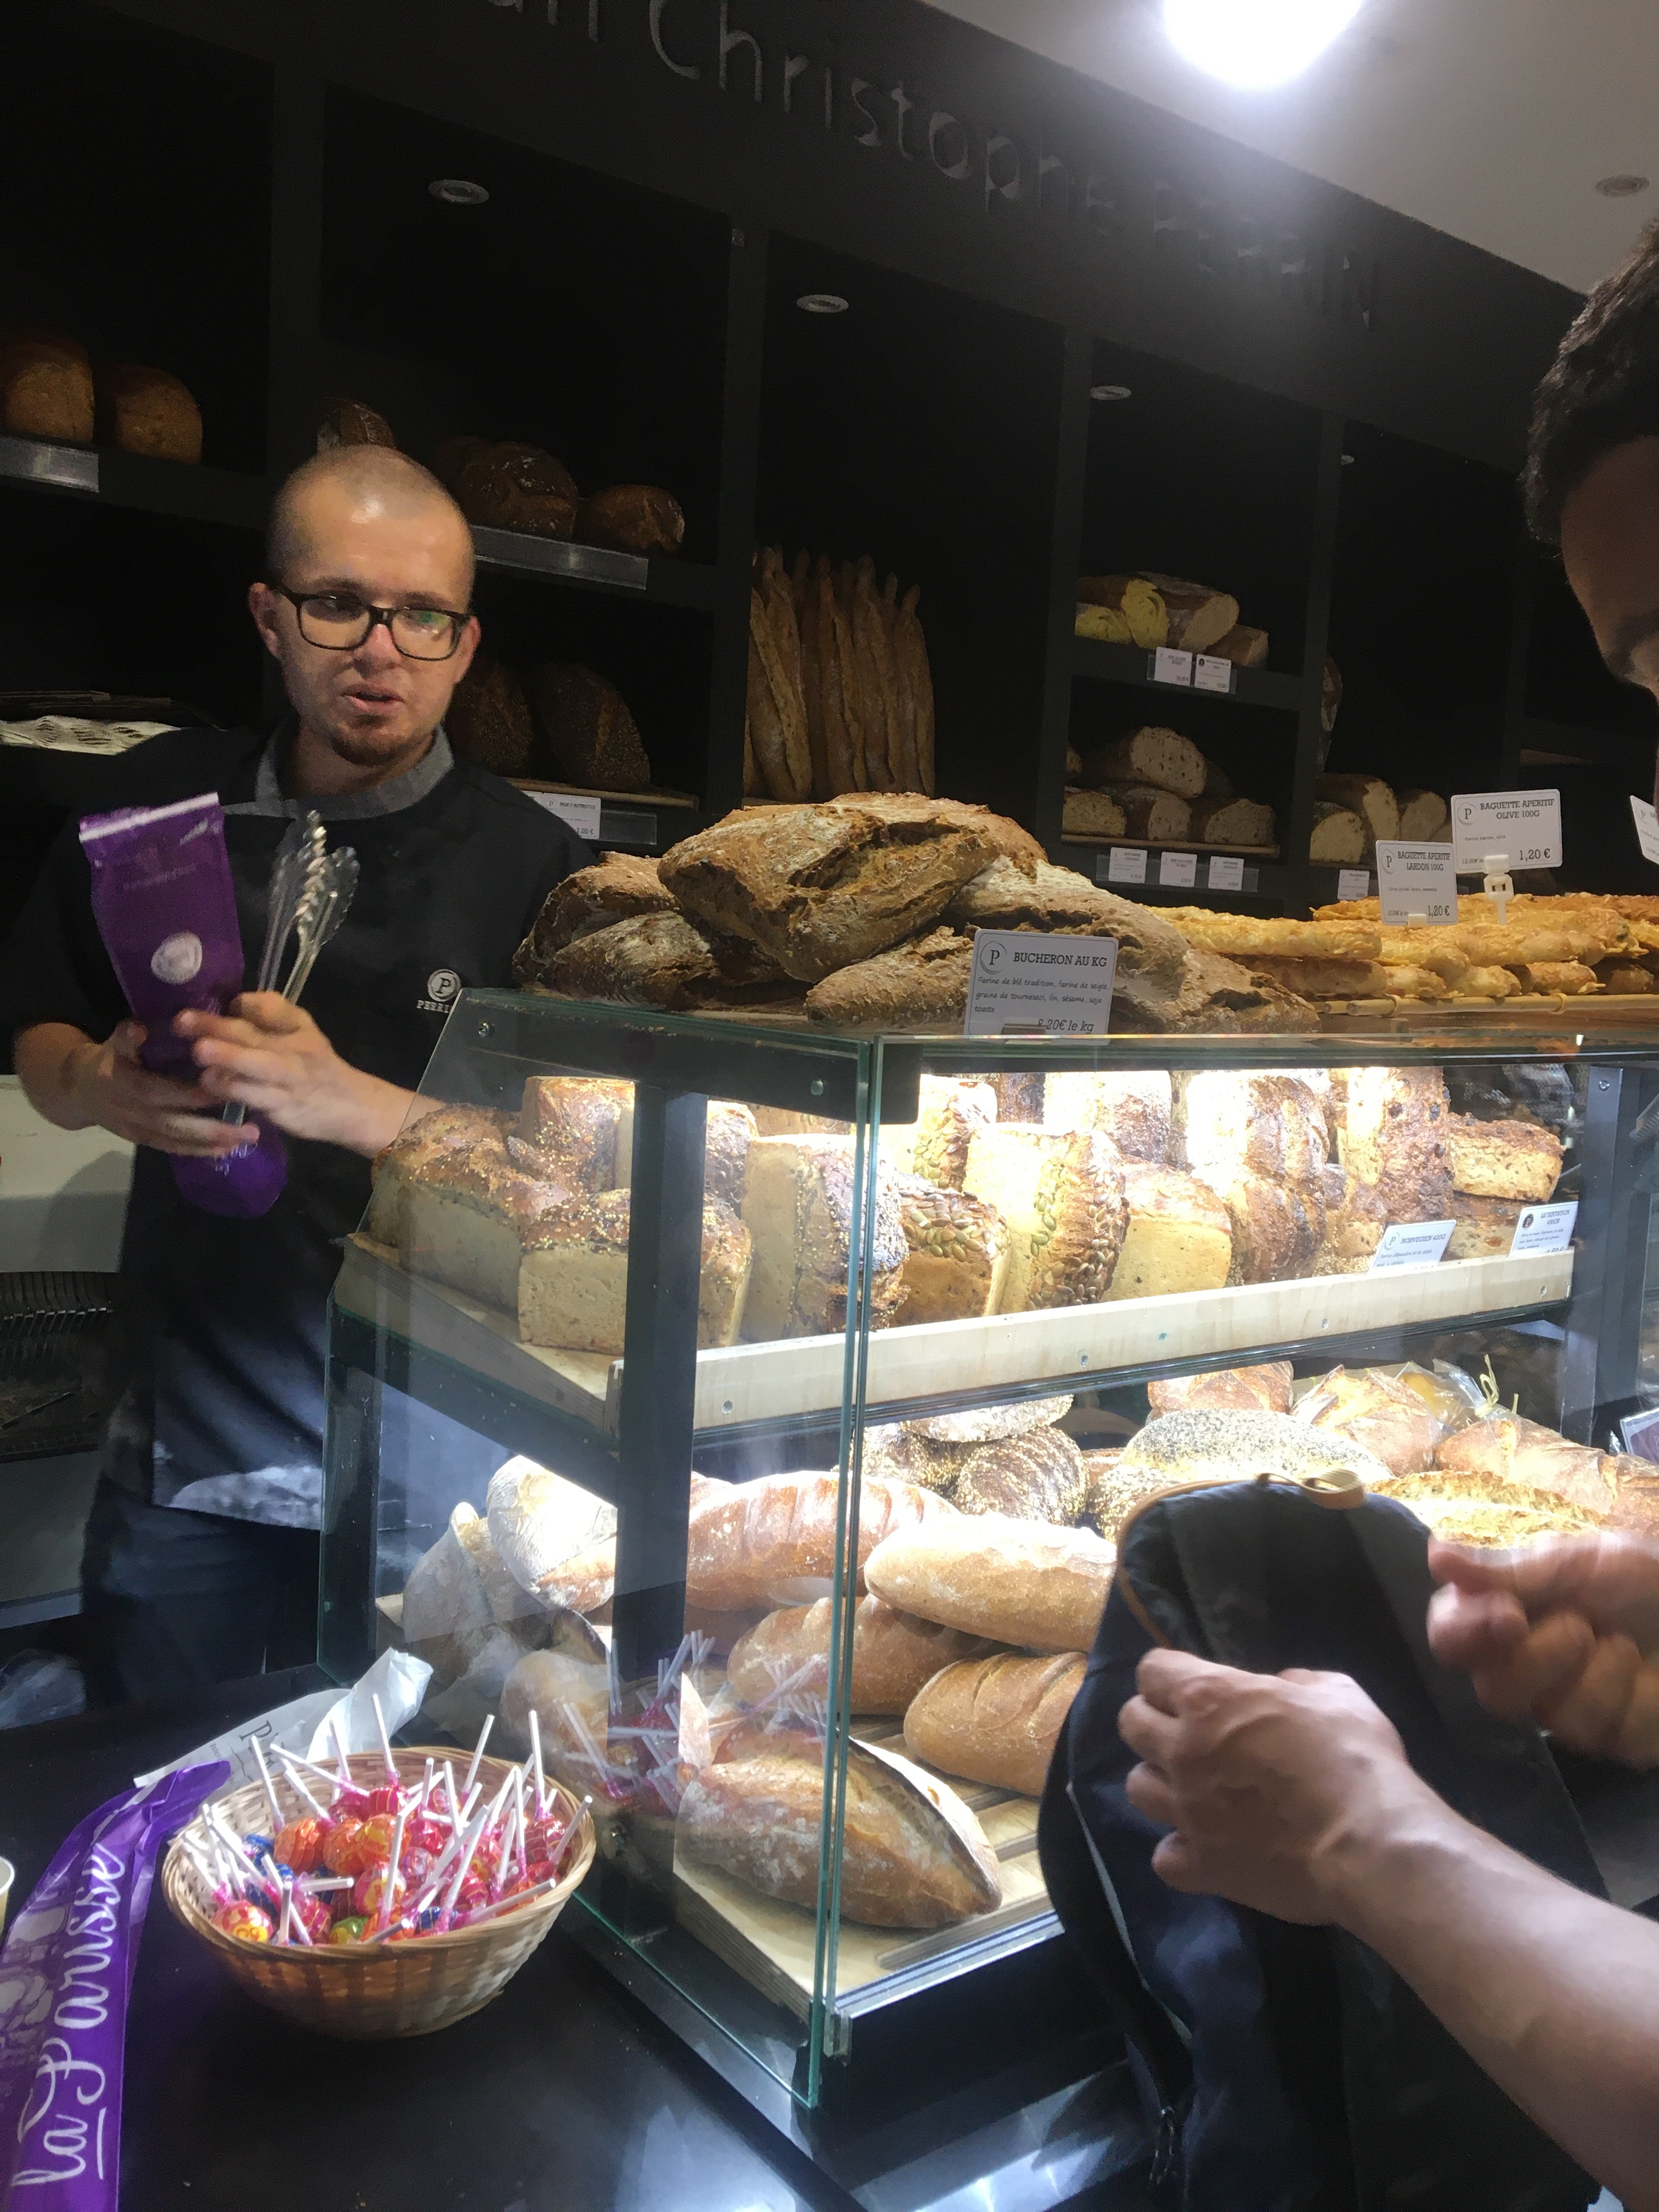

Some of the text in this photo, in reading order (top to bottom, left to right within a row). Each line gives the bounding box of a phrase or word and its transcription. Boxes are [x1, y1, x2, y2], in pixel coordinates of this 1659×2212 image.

[1480, 799, 1555, 810] BAGUETTE APERITIF
[1464, 808, 1471, 820] P
[1522, 810, 1540, 818] 100G
[1386, 855, 1392, 867] P
[1398, 851, 1451, 860] BAGUETTE APERITIF
[1519, 849, 1550, 862] 1,20 €
[1406, 862, 1429, 871] LARDON
[1428, 905, 1449, 917] 1,20 €
[989, 950, 1000, 965] P
[1013, 952, 1107, 967] BUCHERON AU KG
[436, 977, 451, 994] P
[1059, 980, 1078, 988] farine
[975, 991, 997, 1000] graine
[1090, 997, 1102, 1005] soja
[416, 1000, 452, 1013] PERRI
[1068, 1020, 1077, 1031] le
[1080, 1021, 1094, 1034] kg
[1389, 1236, 1396, 1245] P
[1400, 1235, 1432, 1244] NORVEGIEN
